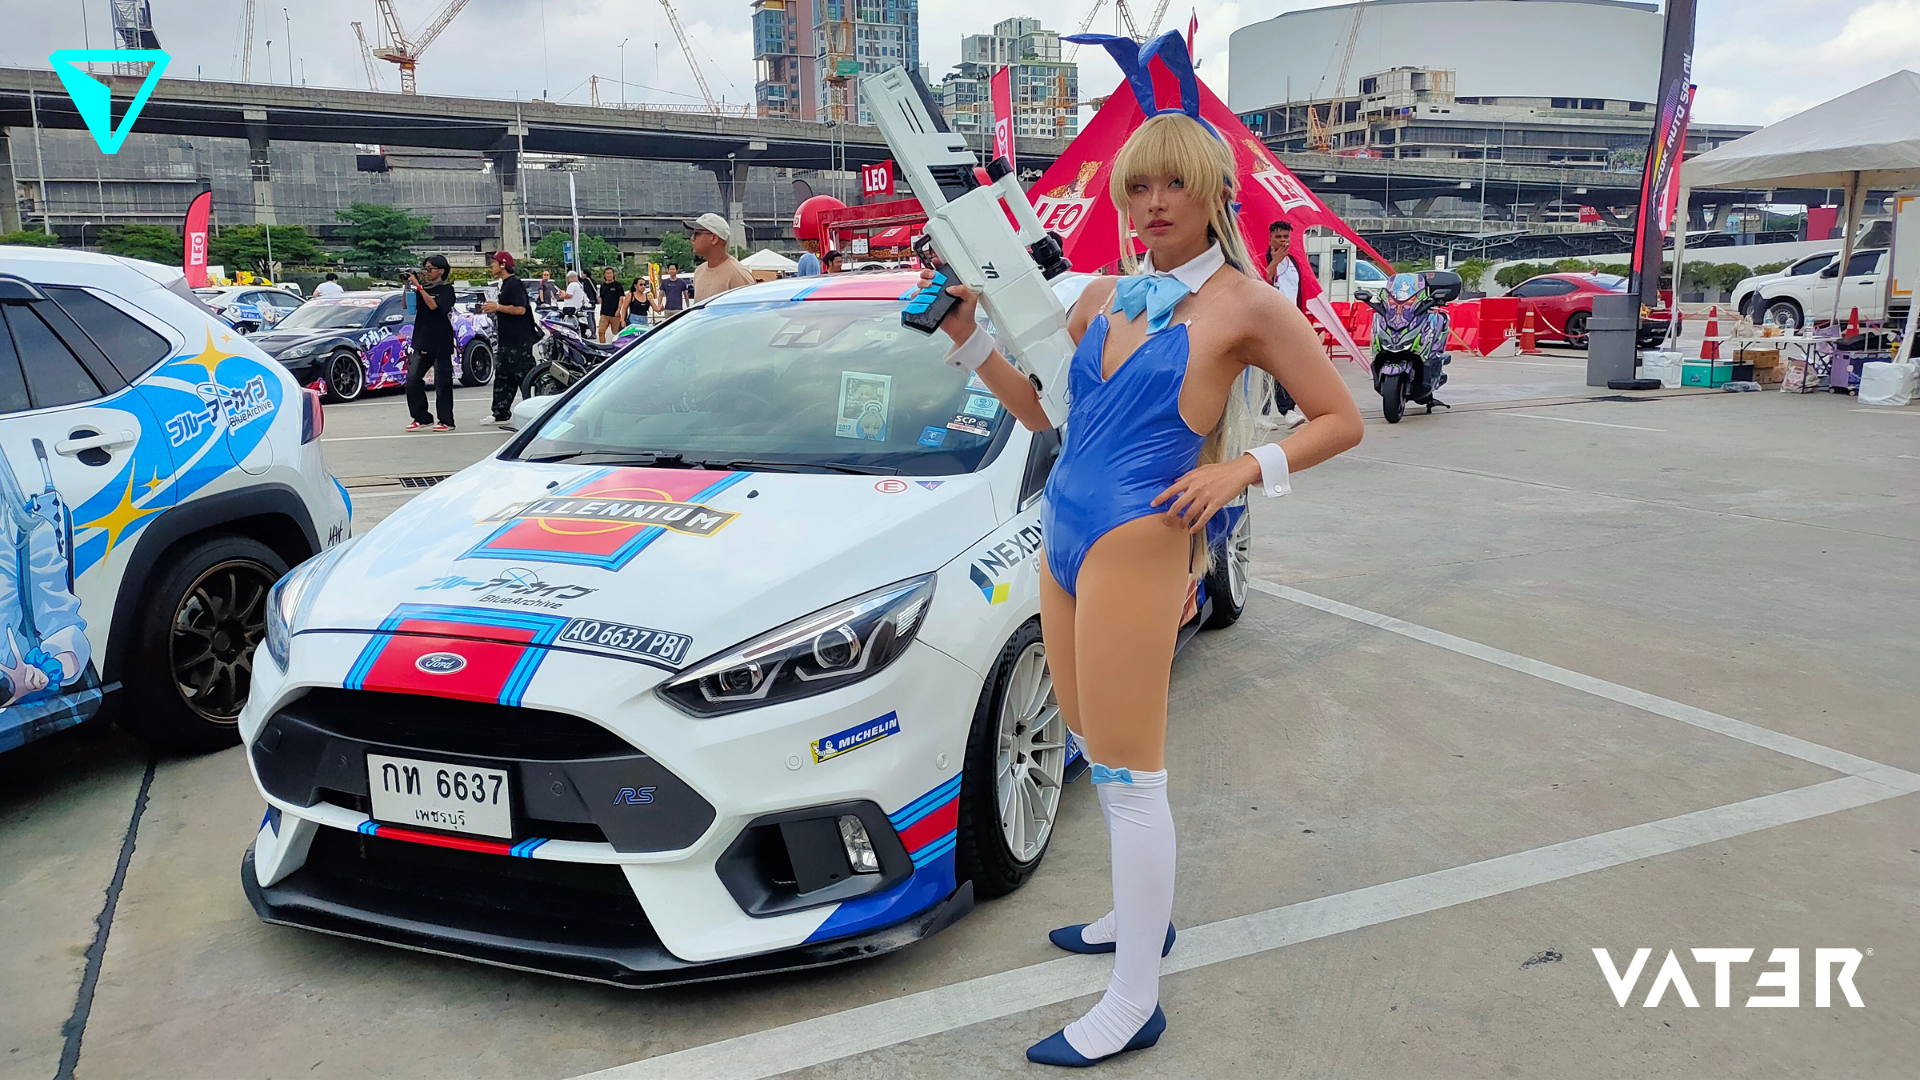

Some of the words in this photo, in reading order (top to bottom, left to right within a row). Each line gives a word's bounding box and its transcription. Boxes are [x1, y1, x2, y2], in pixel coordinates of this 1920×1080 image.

[998, 124, 1007, 156] EO
[1666, 105, 1685, 149] AUTO
[864, 167, 888, 192] LEO
[1263, 175, 1306, 202] LE
[168, 376, 265, 445] ブルーアーカイブ
[228, 400, 272, 428] BlueArchive
[953, 414, 977, 425] SCP
[495, 500, 723, 530] MLLENNIUM
[415, 575, 599, 600] ブルーアーカイブ
[479, 594, 564, 610] BlueArchive
[565, 620, 601, 641] AO
[598, 625, 651, 650] 6637
[647, 633, 686, 661] PBI
[425, 655, 456, 669] Ford
[838, 718, 897, 749] MICHELIN
[382, 763, 421, 795] กท
[436, 769, 503, 805] 6637
[613, 786, 656, 805] RS
